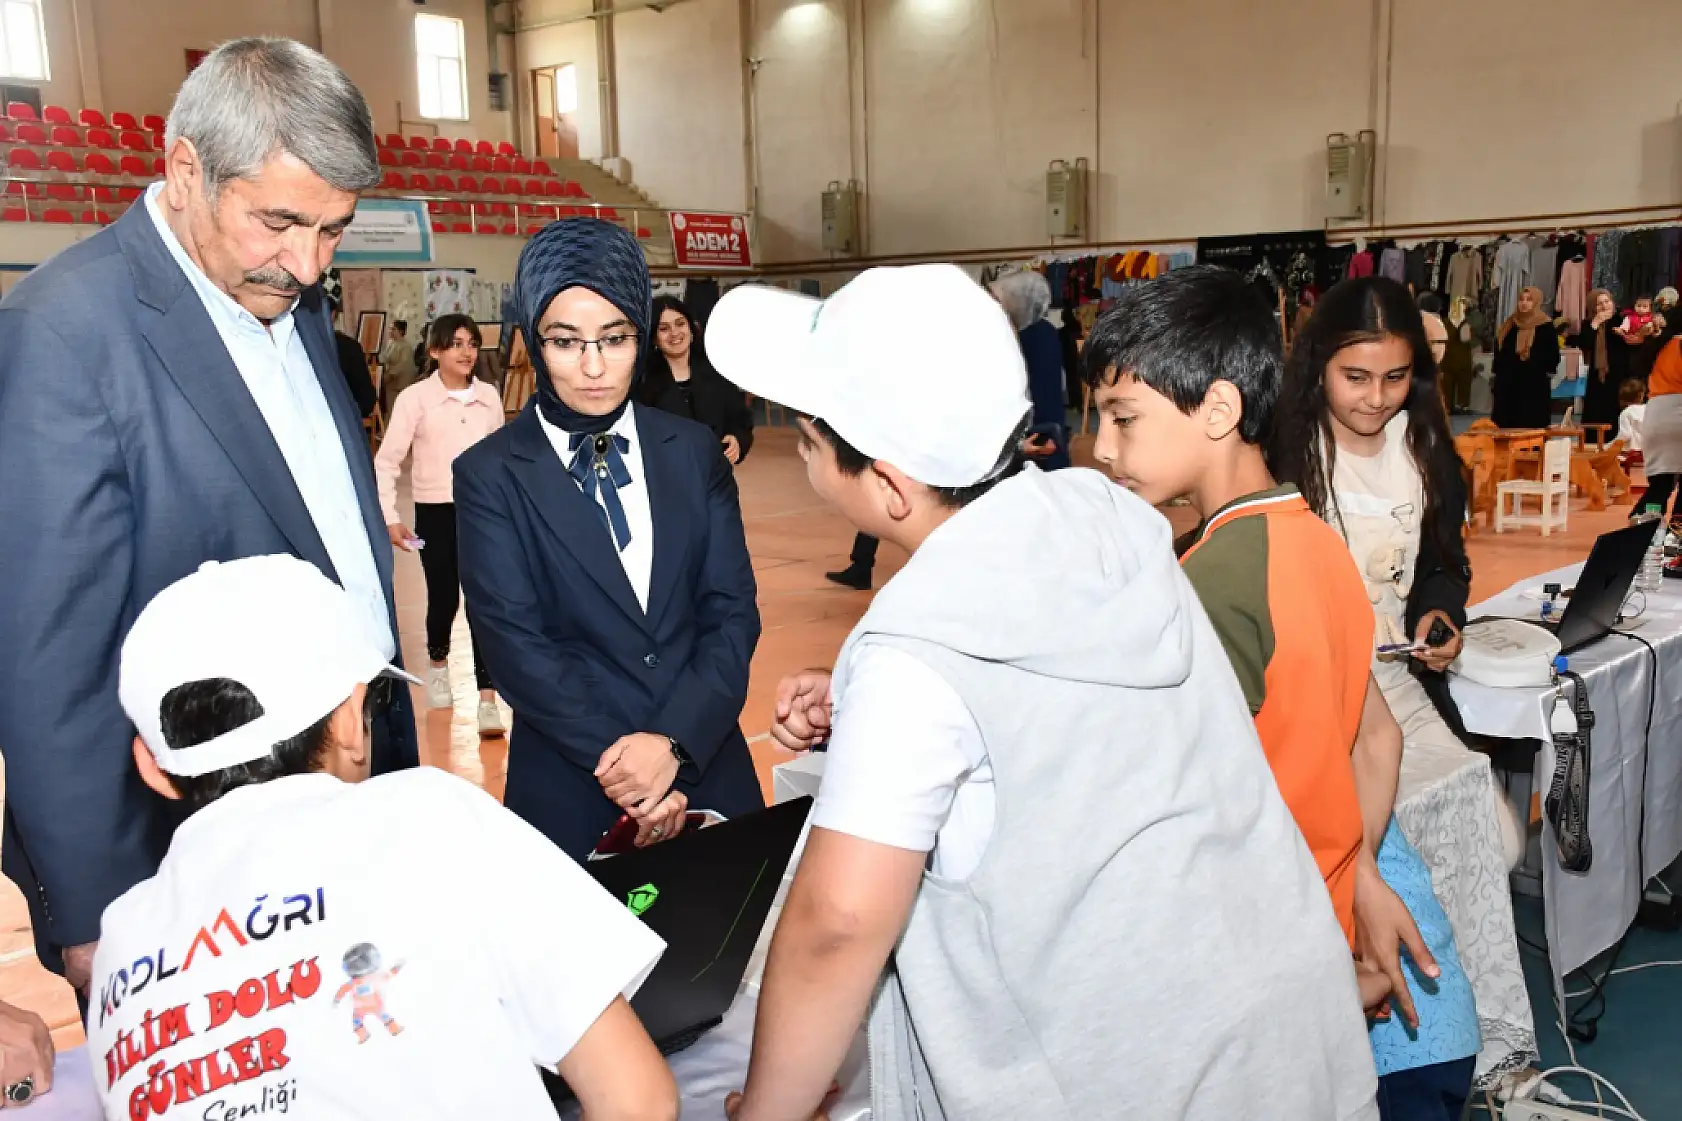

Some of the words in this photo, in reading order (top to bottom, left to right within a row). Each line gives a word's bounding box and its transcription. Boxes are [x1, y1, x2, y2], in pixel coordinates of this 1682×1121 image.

[686, 231, 729, 250] ADEM
[730, 233, 741, 251] 2
[203, 956, 323, 1033] DOLU
[128, 1027, 291, 1121] GÜNLER
